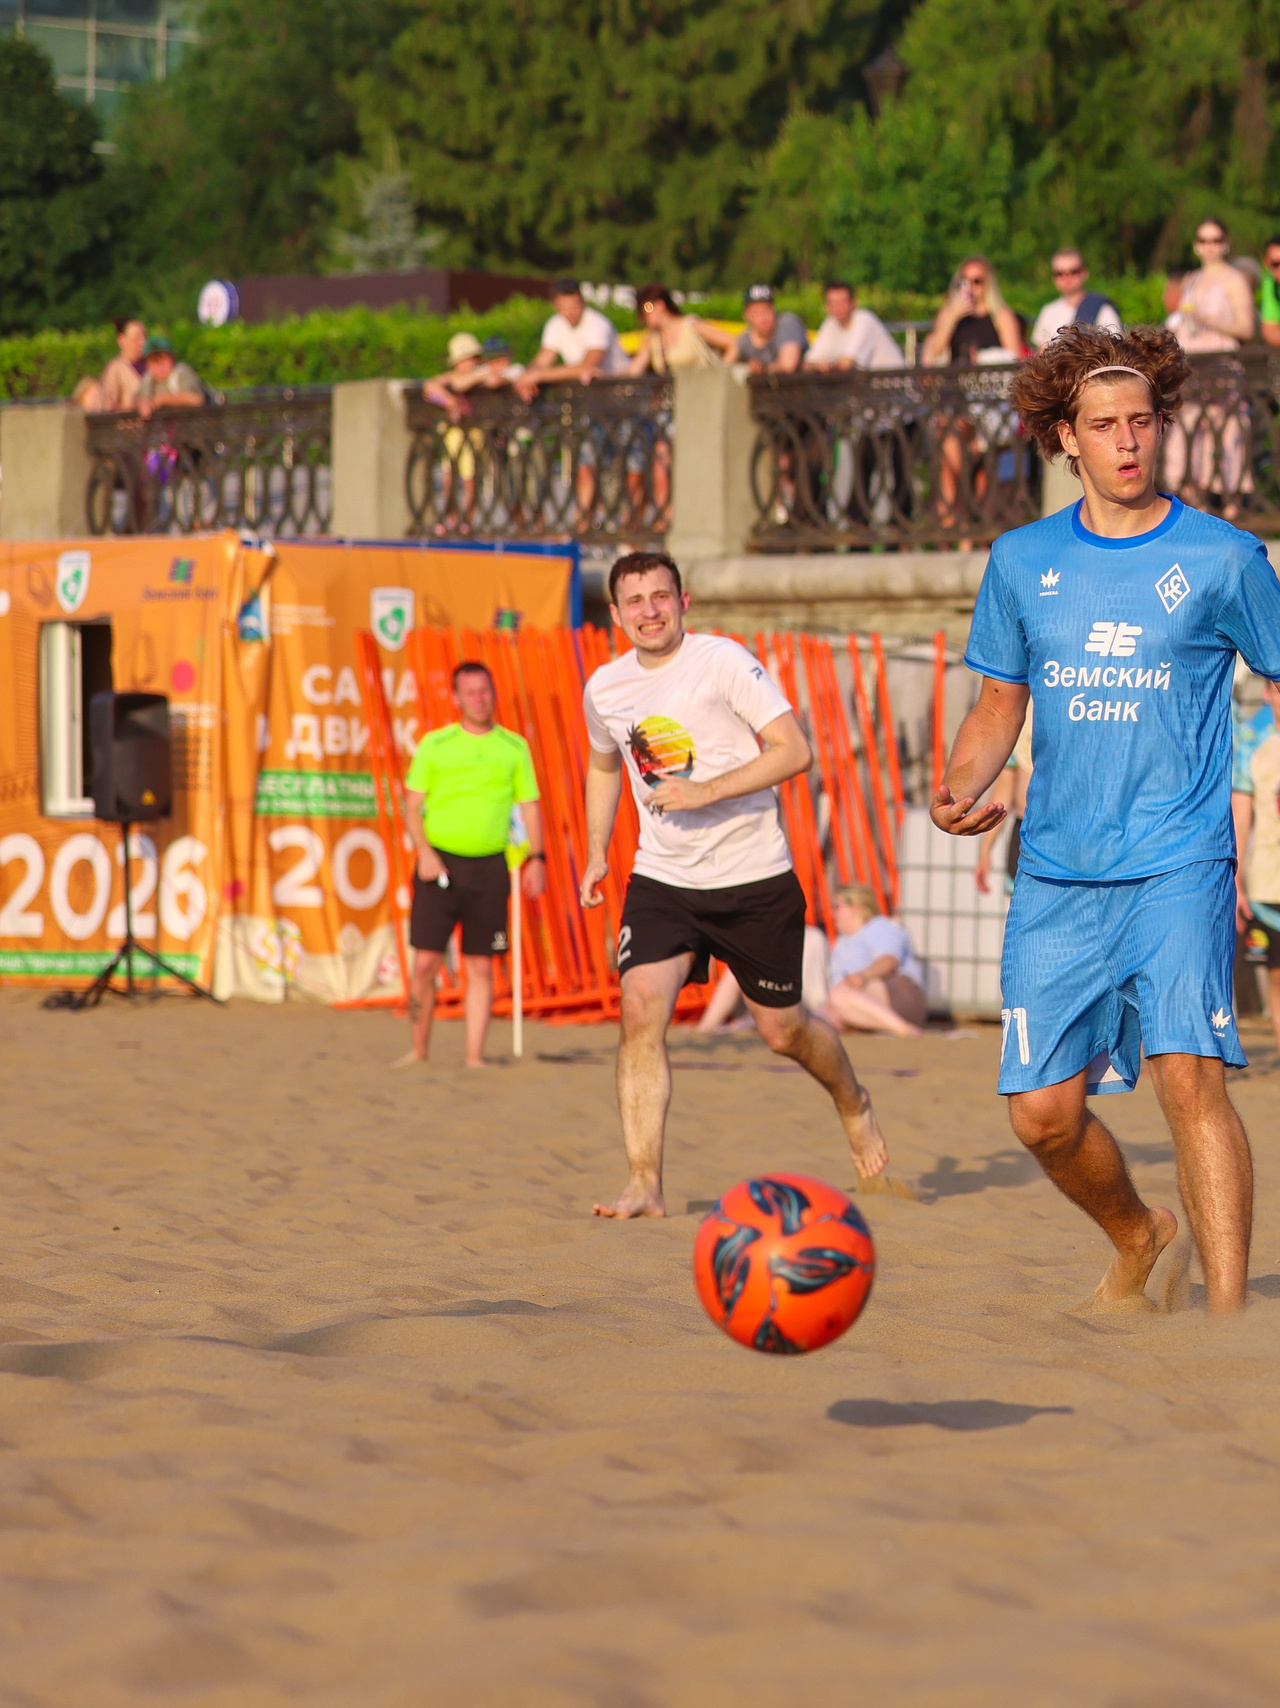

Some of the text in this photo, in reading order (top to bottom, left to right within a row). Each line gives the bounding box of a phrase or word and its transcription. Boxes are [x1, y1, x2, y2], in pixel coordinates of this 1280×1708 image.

[1043, 660, 1171, 691] Земский
[1068, 692, 1141, 722] банк
[0, 832, 208, 941] 2026
[269, 824, 413, 911] 20
